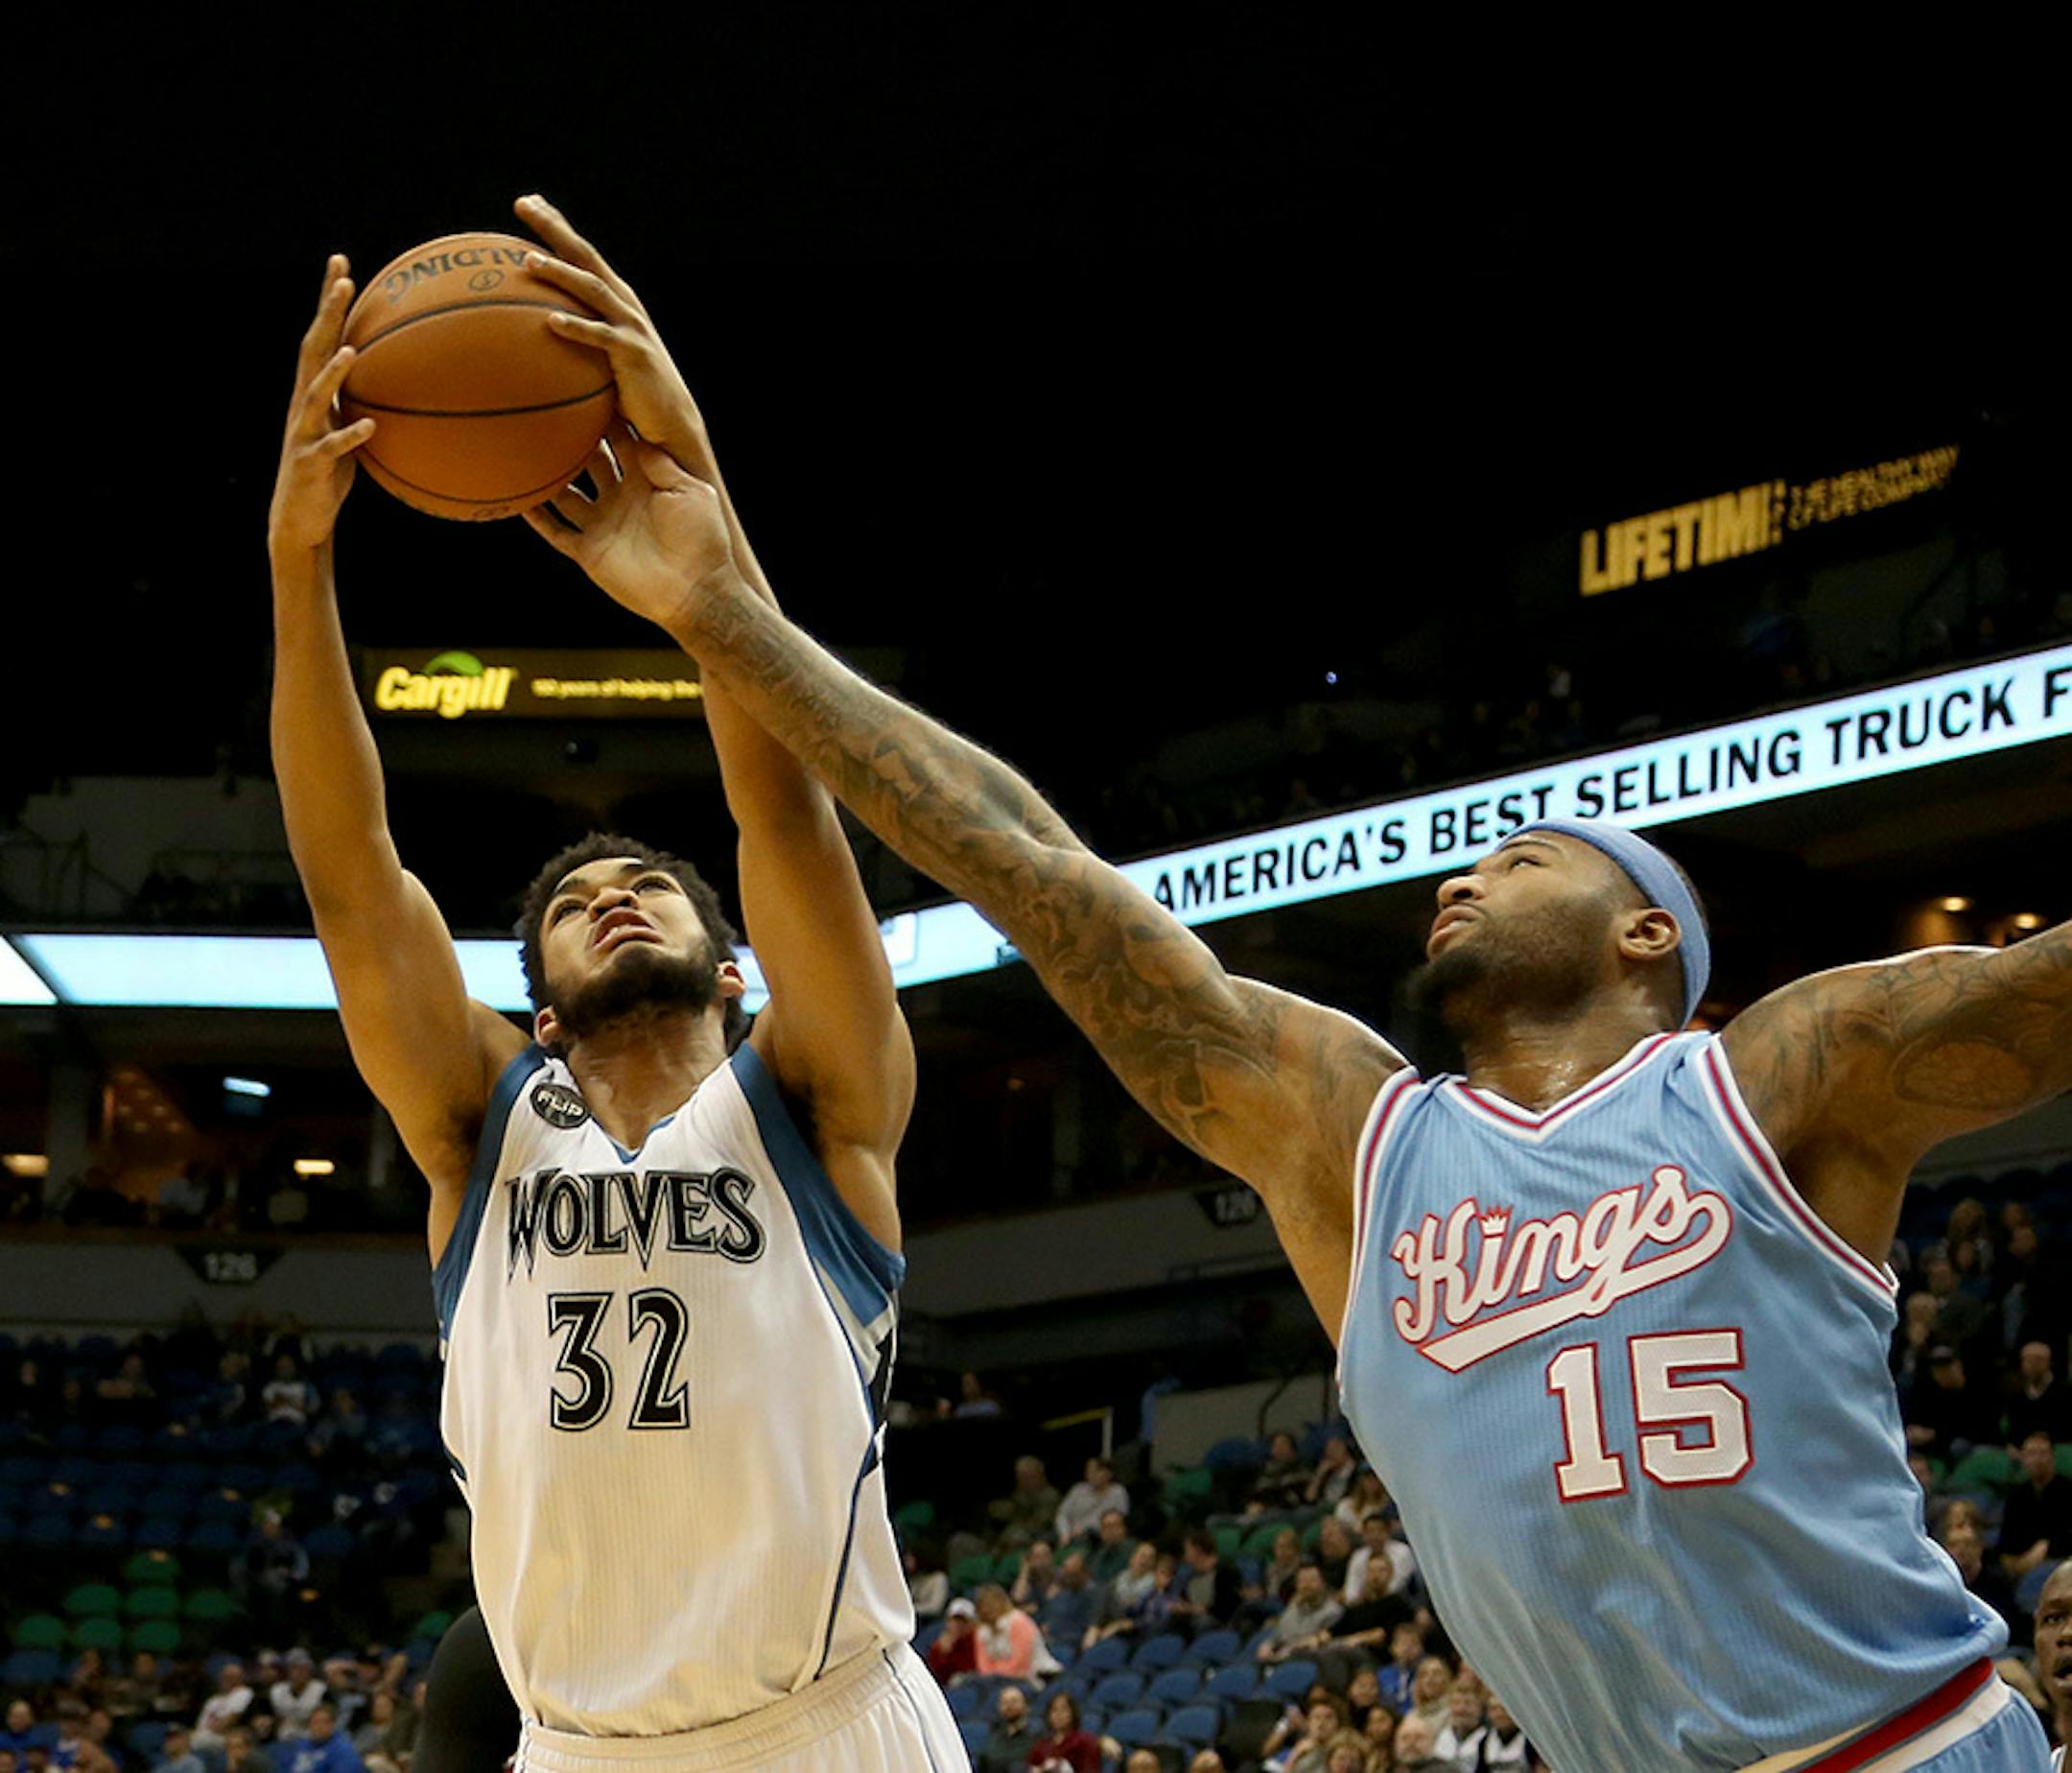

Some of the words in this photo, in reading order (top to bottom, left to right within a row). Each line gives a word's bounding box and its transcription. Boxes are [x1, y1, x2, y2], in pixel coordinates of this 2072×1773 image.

[386, 246, 530, 306] ALDING
[375, 666, 519, 719] Cargill
[1154, 820, 1407, 912] AMERICA'S
[1429, 784, 1554, 856] BEST
[1574, 729, 1801, 818] SELLING
[1825, 675, 2016, 766] TRUCK
[506, 1168, 766, 1284] WOLVES
[1389, 1164, 1734, 1375] Kings
[547, 1287, 691, 1432] 32
[1545, 1327, 1755, 1504] 15
